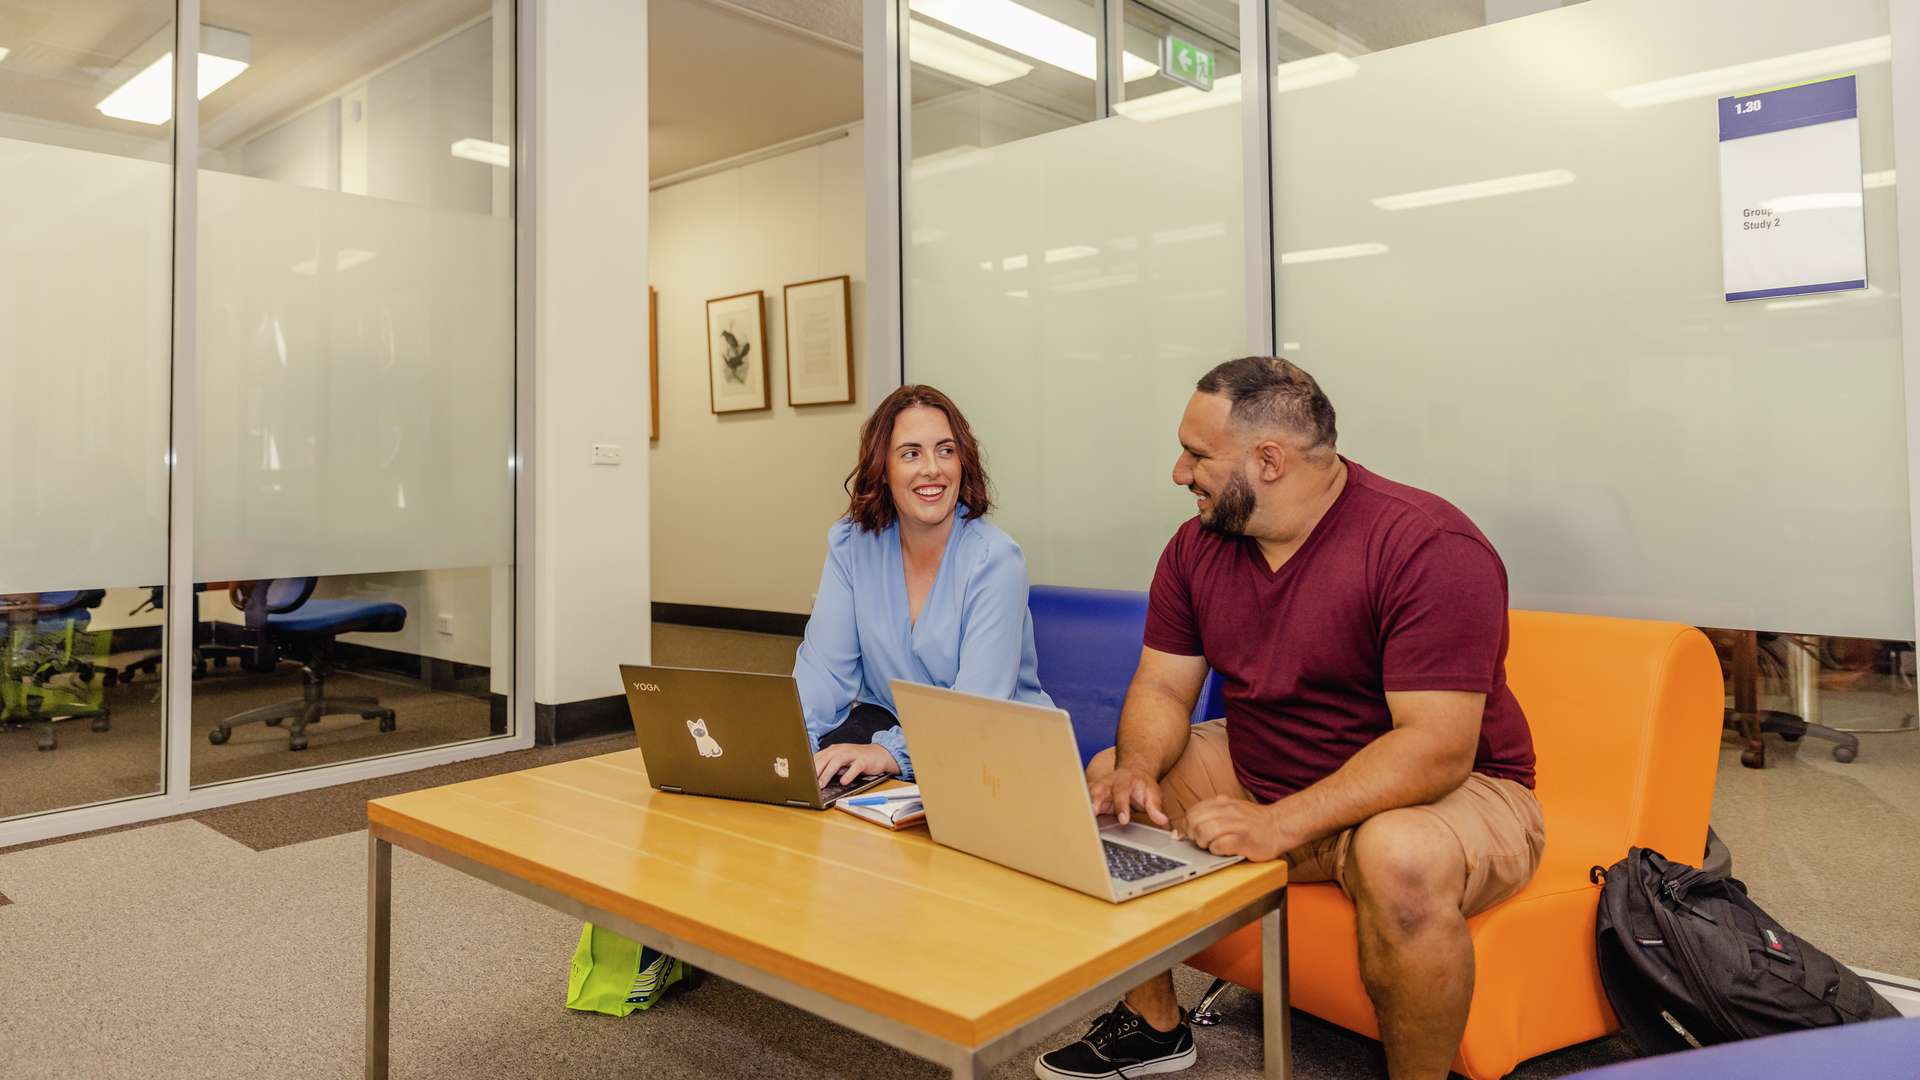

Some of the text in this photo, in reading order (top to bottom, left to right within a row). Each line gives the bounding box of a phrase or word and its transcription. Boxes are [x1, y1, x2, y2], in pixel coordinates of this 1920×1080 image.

[1743, 208, 1773, 218] Group
[1743, 217, 1781, 231] Study 2
[633, 682, 661, 692] YOGA
